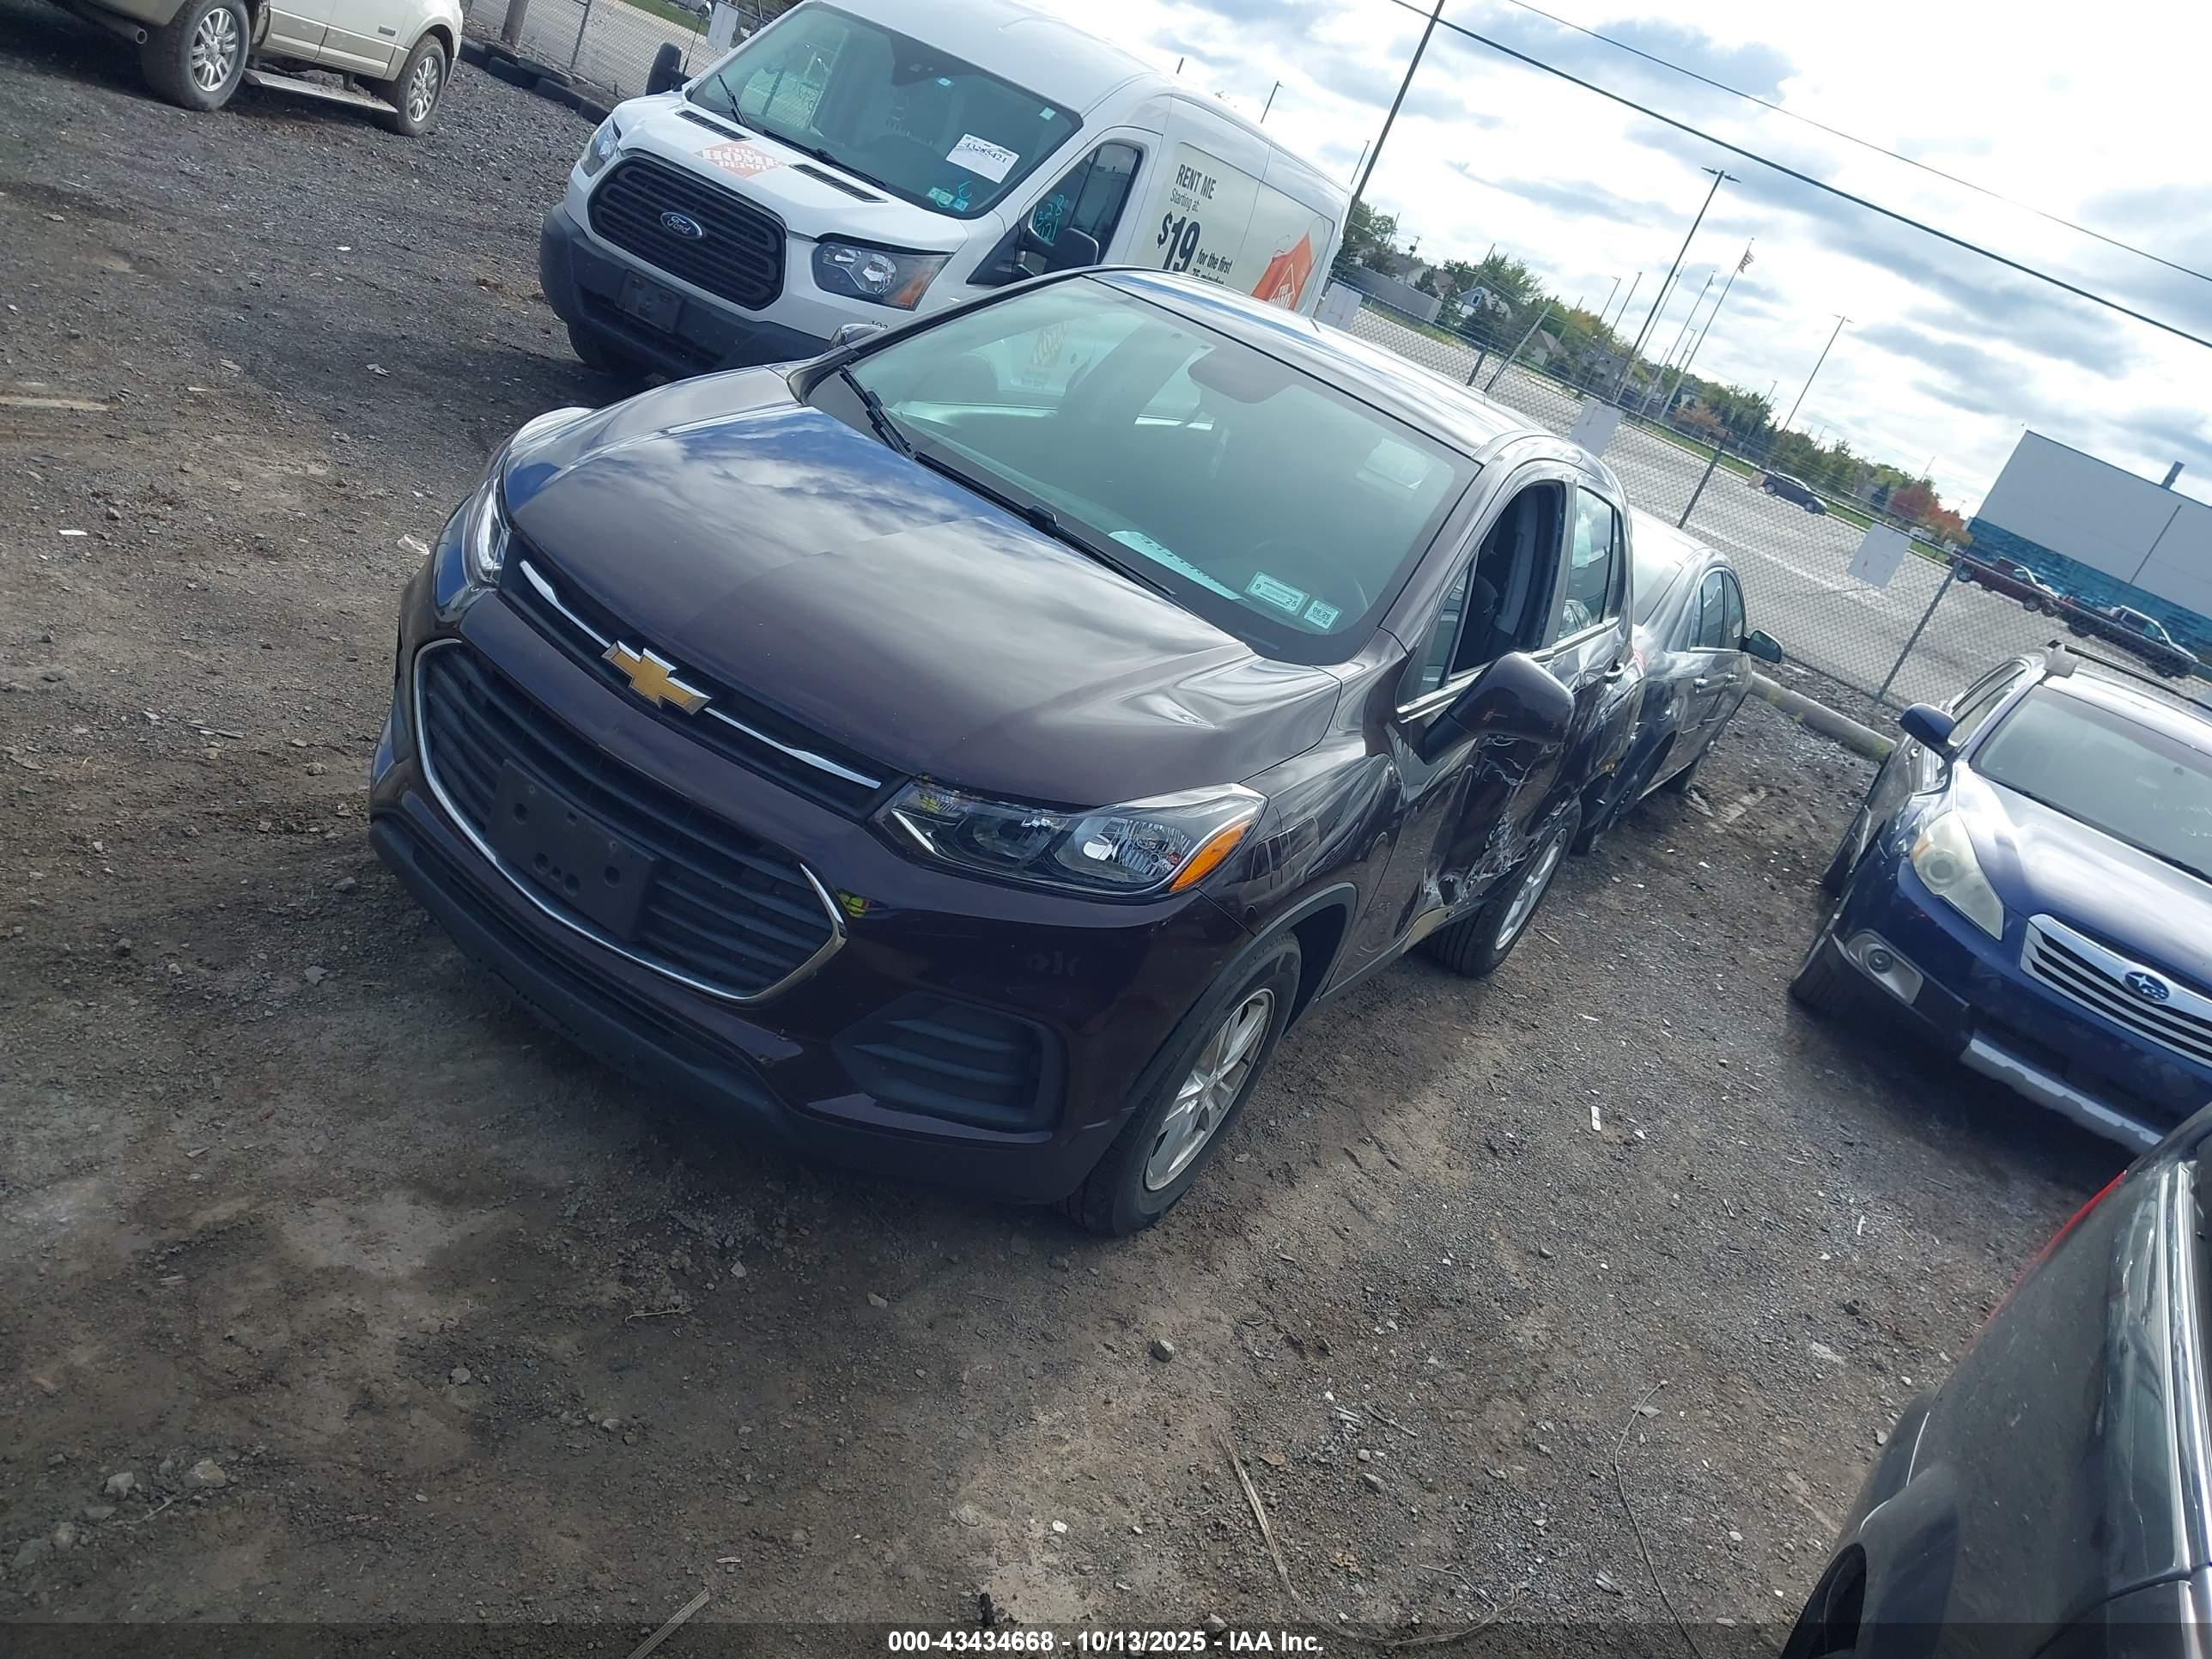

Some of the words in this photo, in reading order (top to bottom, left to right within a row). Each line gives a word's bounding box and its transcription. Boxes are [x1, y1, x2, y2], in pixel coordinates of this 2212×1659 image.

[1176, 164, 1202, 193] RENT
[1200, 175, 1217, 200] ME
[1170, 187, 1192, 212] Starting
[666, 216, 692, 234] Ford
[1157, 210, 1201, 272] $19
[1196, 248, 1208, 266] for
[1206, 251, 1219, 269] the
[1217, 256, 1233, 275] first
[1286, 598, 1298, 607] 25
